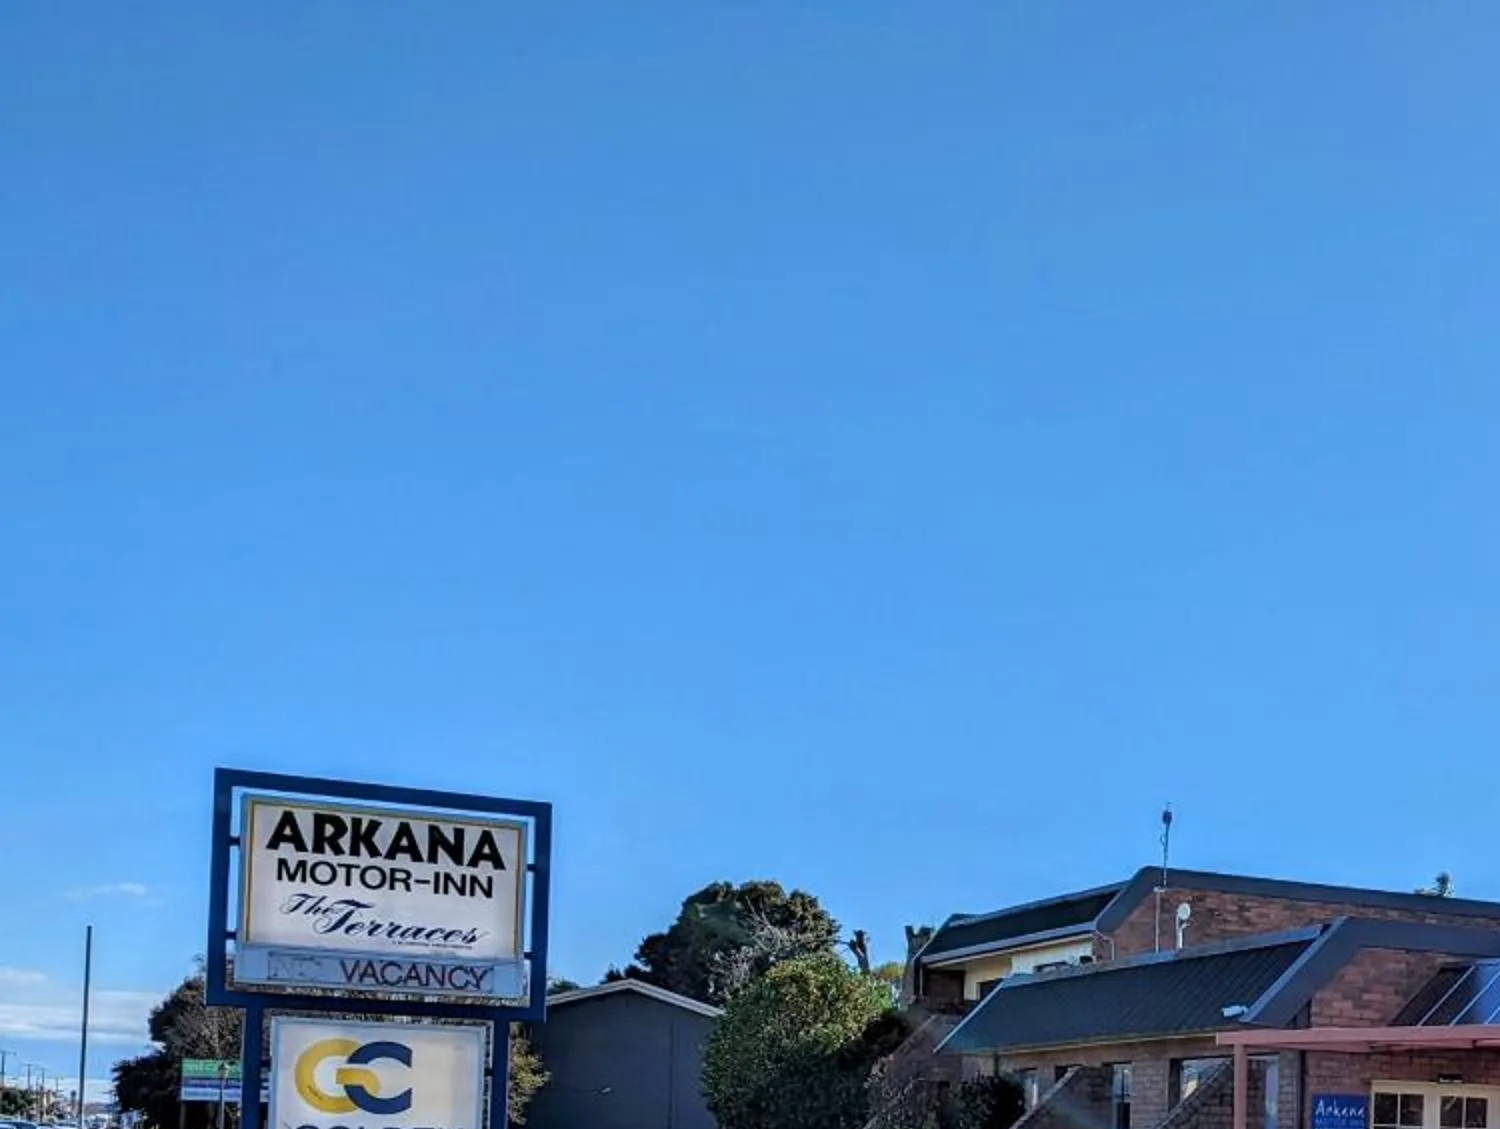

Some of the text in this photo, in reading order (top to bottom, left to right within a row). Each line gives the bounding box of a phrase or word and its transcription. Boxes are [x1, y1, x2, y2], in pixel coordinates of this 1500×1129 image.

[266, 810, 506, 870] ARKANA
[276, 858, 494, 898] MOTOR-INN
[279, 893, 488, 944] The Terraces
[340, 959, 490, 990] VACANCY
